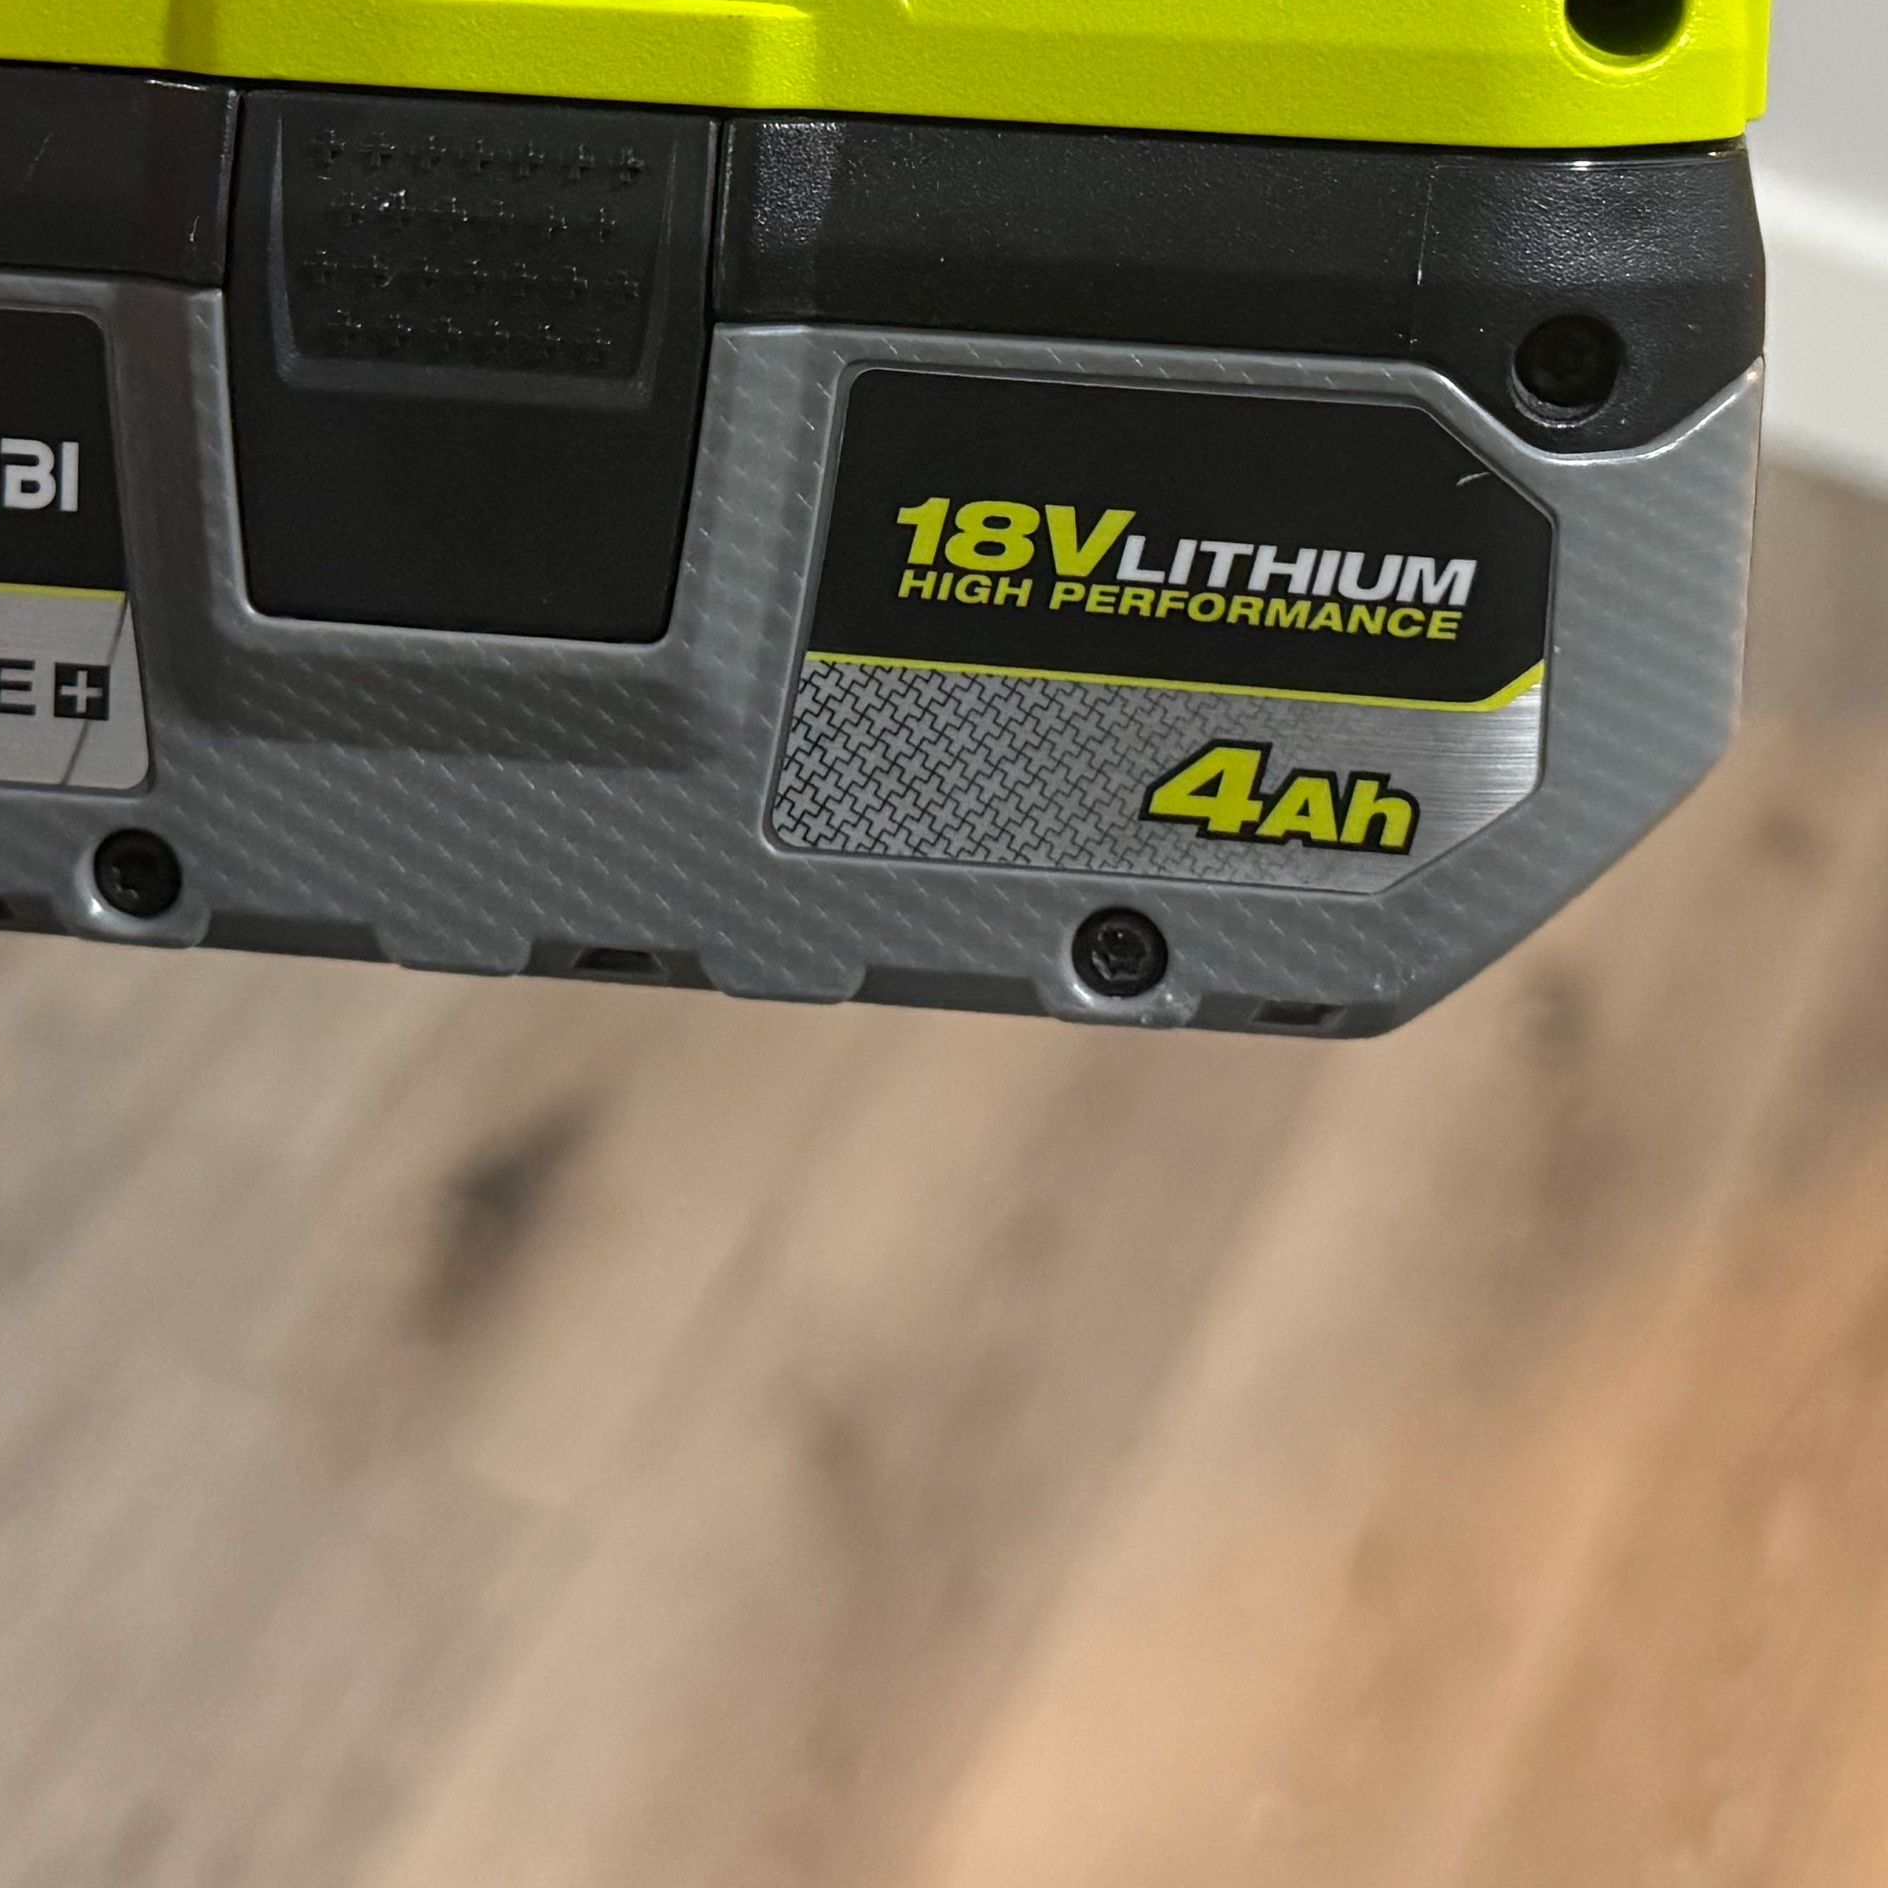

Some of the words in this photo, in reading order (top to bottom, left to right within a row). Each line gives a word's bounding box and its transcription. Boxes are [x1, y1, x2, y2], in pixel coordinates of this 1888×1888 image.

[896, 497, 1136, 577] 18V
[1115, 535, 1477, 607] LITHIUM
[898, 568, 1030, 608] HIGH
[1049, 582, 1464, 641] PERFORMANCE
[1144, 741, 1418, 852] 4Ah
